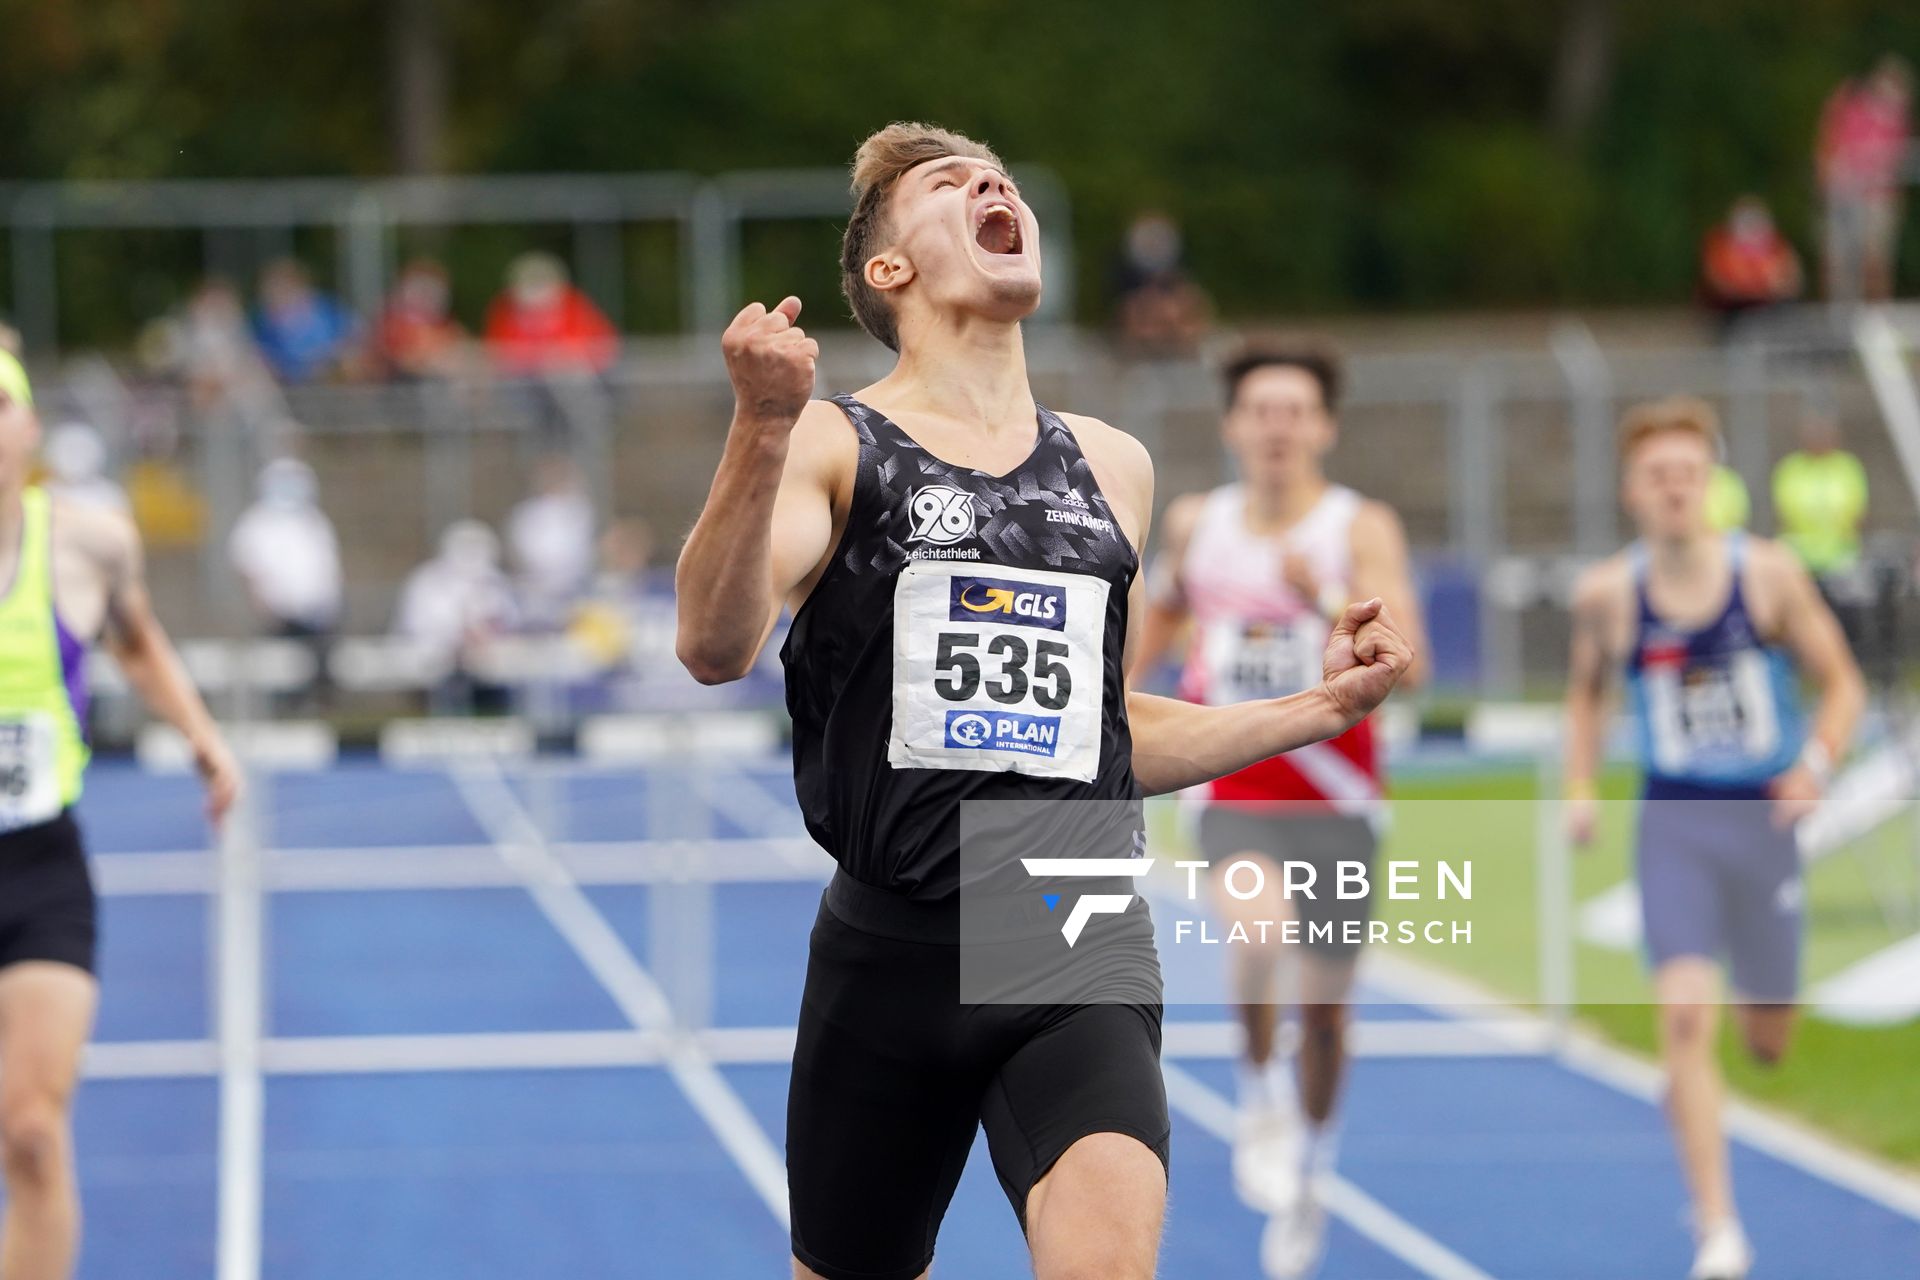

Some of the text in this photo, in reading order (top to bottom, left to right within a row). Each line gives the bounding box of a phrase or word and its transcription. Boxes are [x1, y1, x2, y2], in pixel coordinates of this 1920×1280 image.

[1062, 498, 1090, 510] adidas
[914, 494, 970, 541] 96
[1044, 509, 1112, 532] ZEHNKAMPF
[906, 548, 981, 560] Leichtathletik
[1014, 592, 1058, 620] GLS
[933, 632, 1072, 711] 535
[996, 719, 1056, 744] PLAN
[995, 741, 1051, 755] INTERNATIONAL
